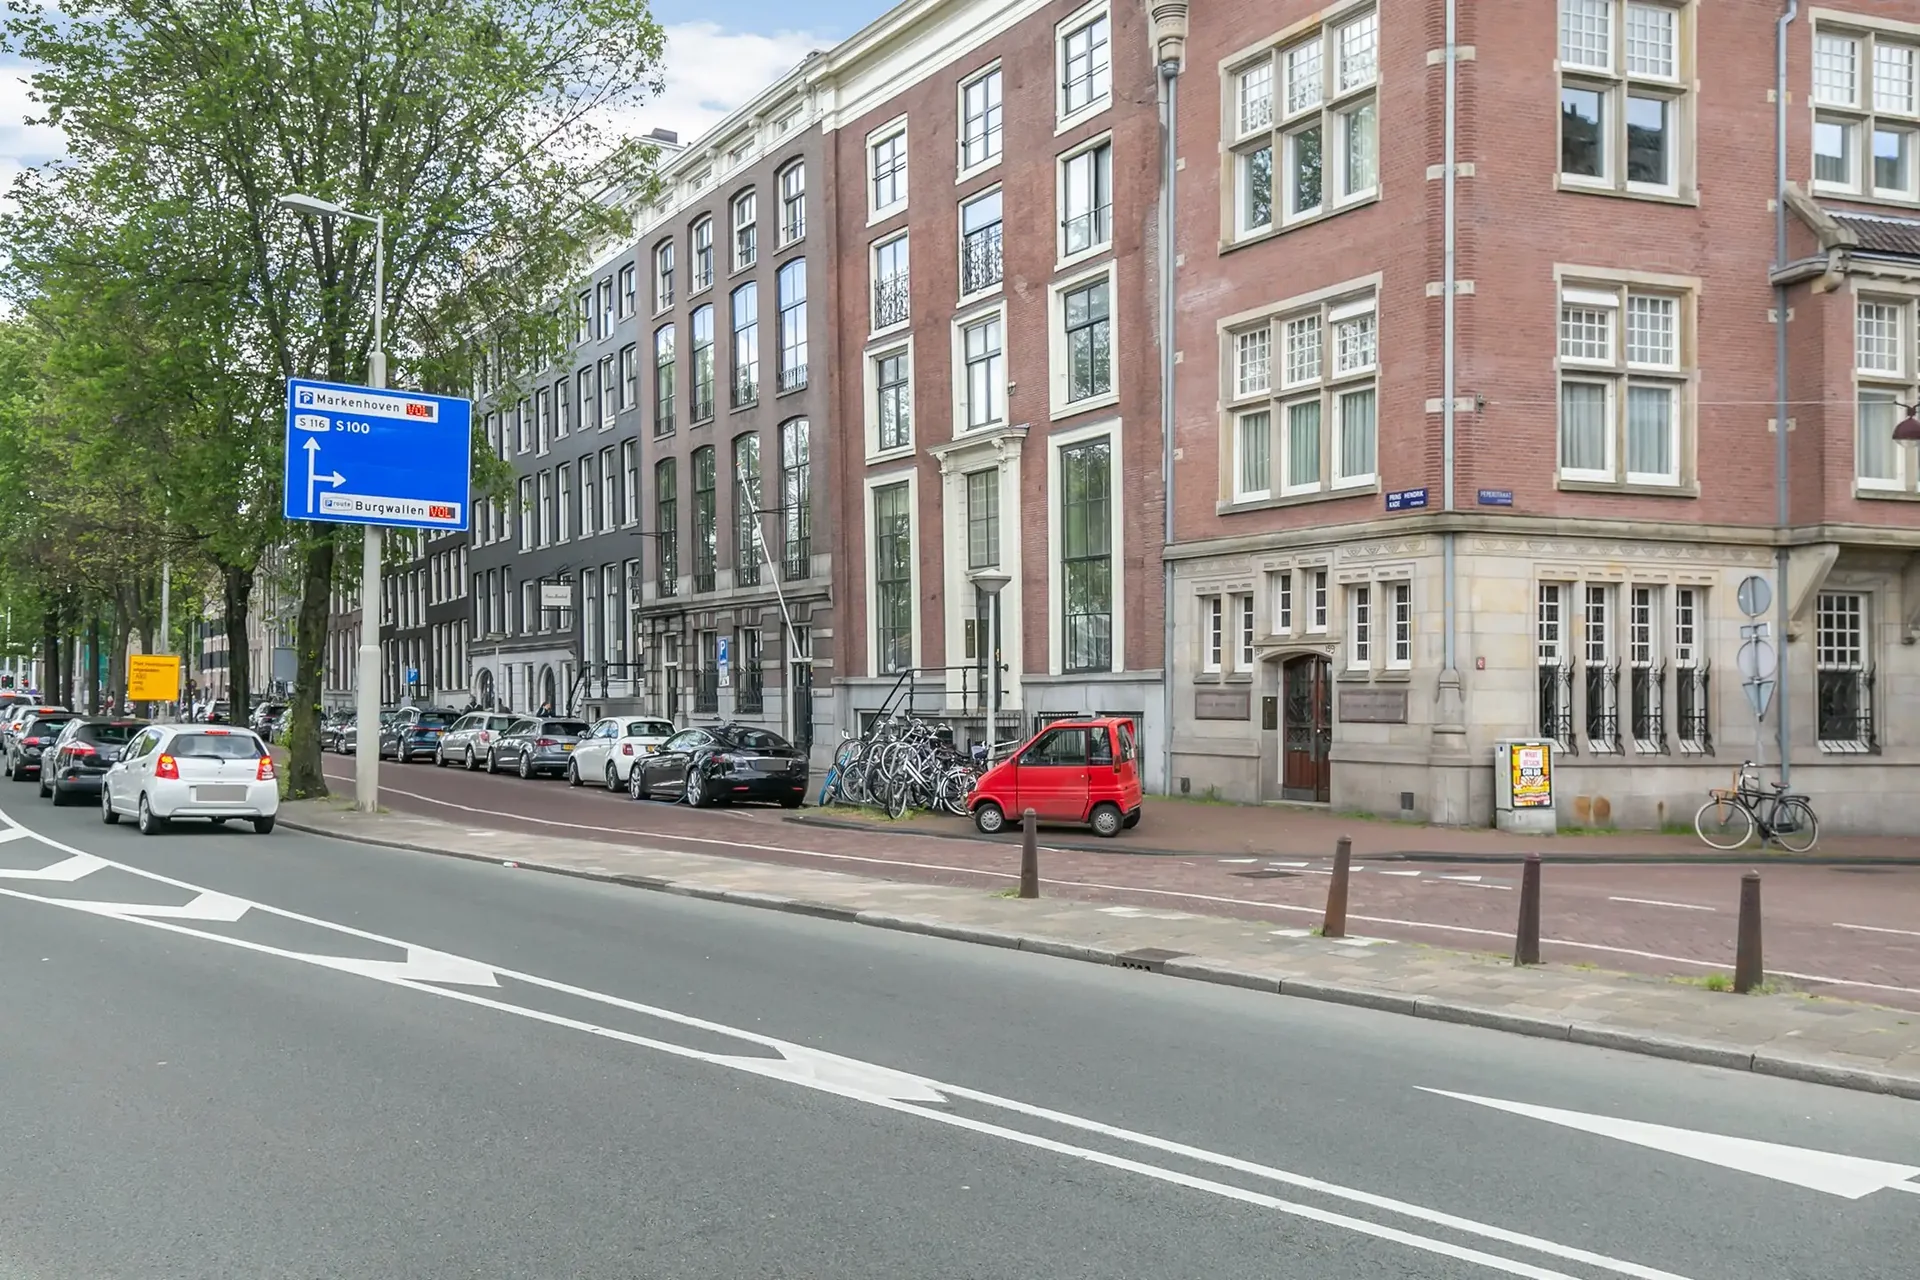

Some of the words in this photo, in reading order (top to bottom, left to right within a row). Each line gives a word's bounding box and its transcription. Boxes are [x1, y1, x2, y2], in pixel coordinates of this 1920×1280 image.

[316, 393, 400, 413] Markenhoven
[406, 403, 429, 417] VOL
[299, 417, 306, 427] S
[310, 418, 325, 428] 116
[336, 420, 371, 434] S100
[333, 499, 351, 509] route
[354, 500, 425, 517] Burgwallen
[429, 505, 451, 518] VOL
[1325, 644, 1335, 655] 159
